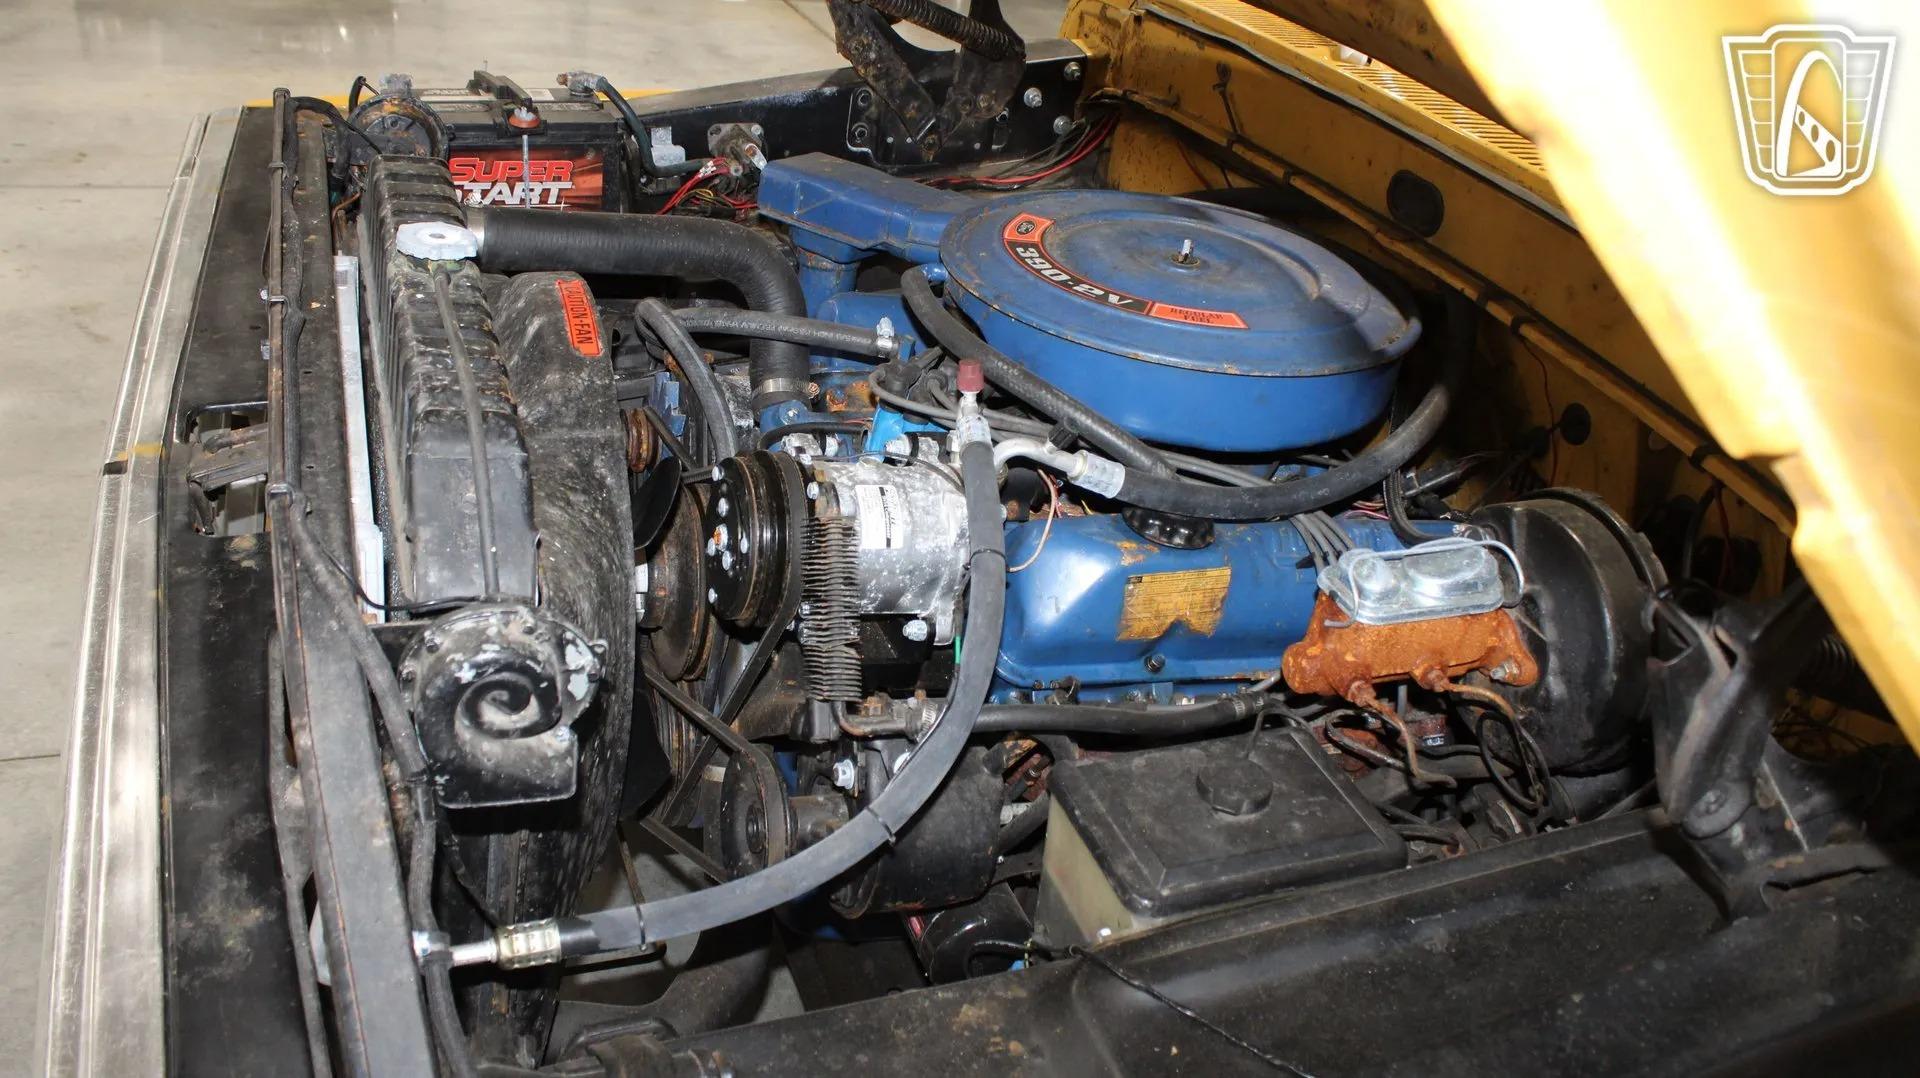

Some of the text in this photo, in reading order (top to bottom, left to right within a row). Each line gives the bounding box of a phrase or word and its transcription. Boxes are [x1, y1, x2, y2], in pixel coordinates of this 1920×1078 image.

[448, 157, 574, 183] SUPER
[1170, 307, 1224, 319] REGULAR
[1183, 314, 1212, 324] FUEL
